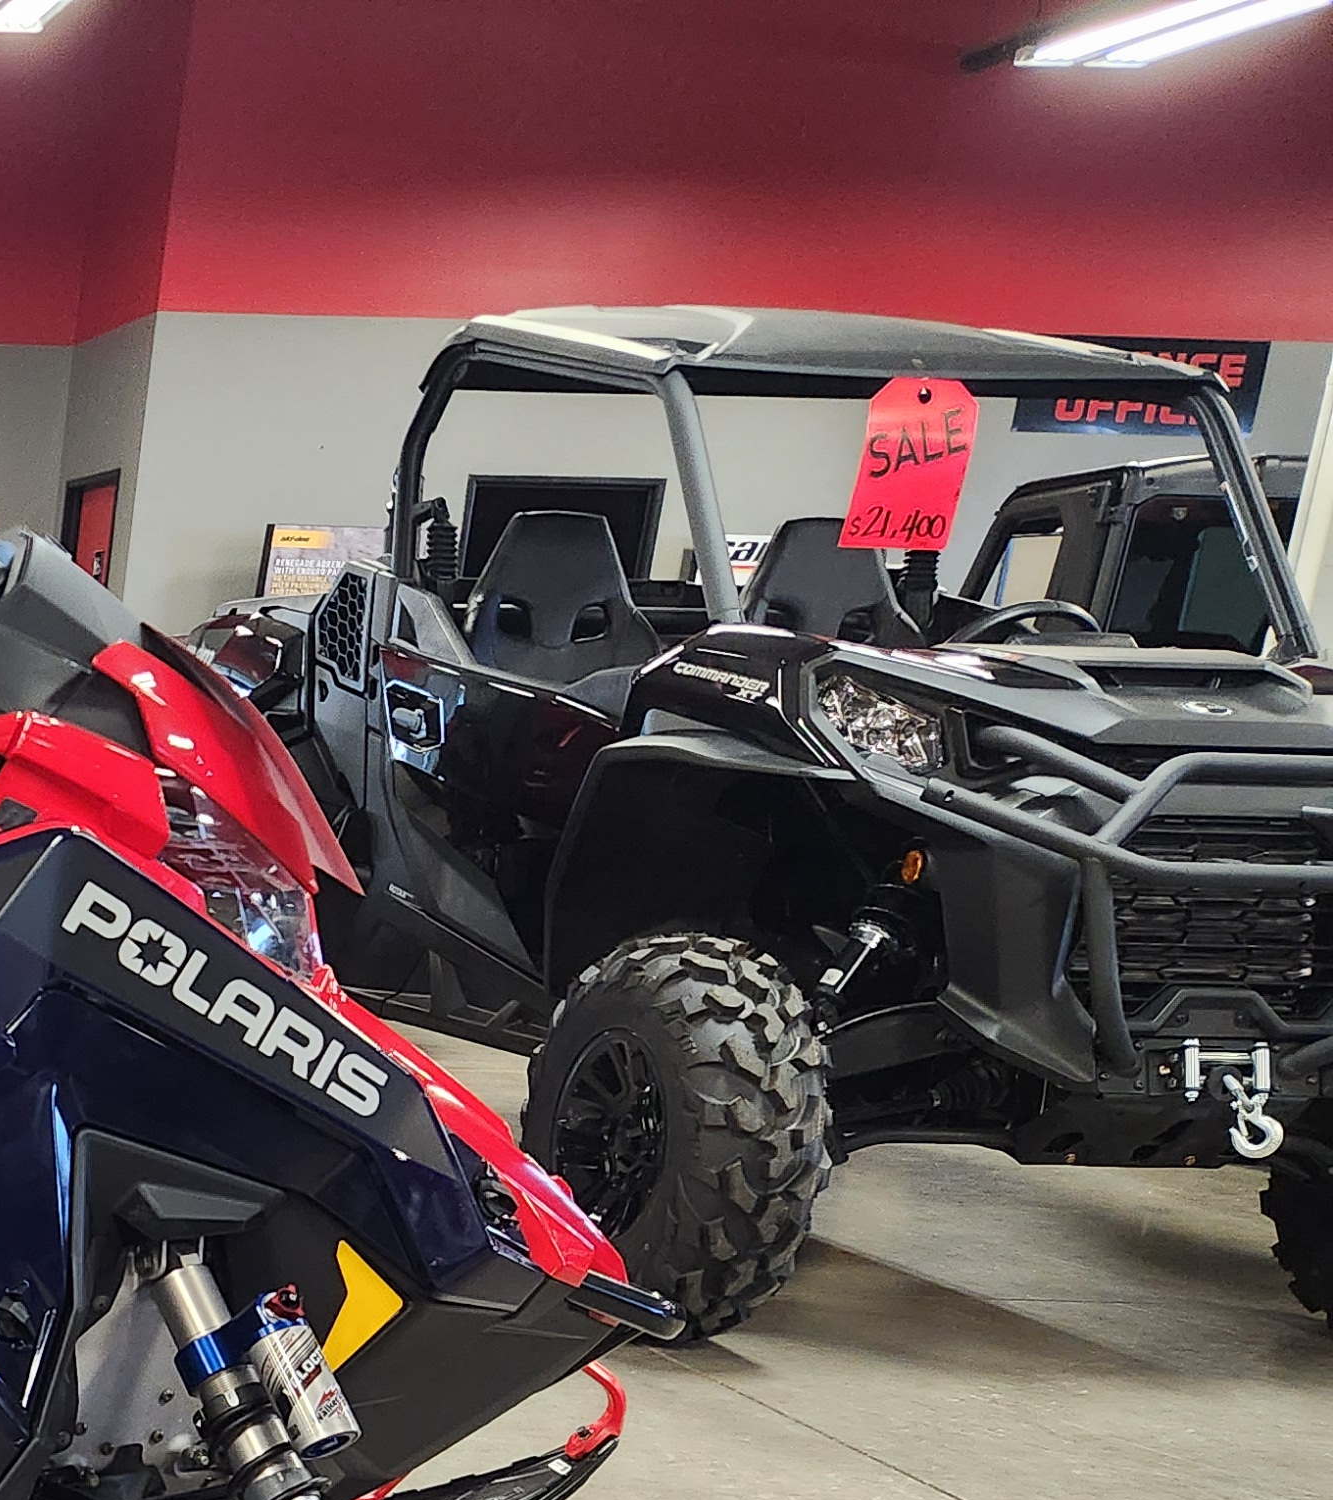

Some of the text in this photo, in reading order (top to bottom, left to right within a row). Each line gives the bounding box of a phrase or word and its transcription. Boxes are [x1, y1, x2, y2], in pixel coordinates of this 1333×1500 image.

[1055, 398, 1199, 426] OFFIC
[868, 407, 967, 479] SALE
[848, 505, 948, 543] $21,400
[274, 567, 294, 575] WITH
[275, 558, 314, 568] RENEGADE
[673, 661, 770, 693] COMMANDER
[736, 688, 763, 700] XT
[61, 880, 389, 1118] POLARIS
